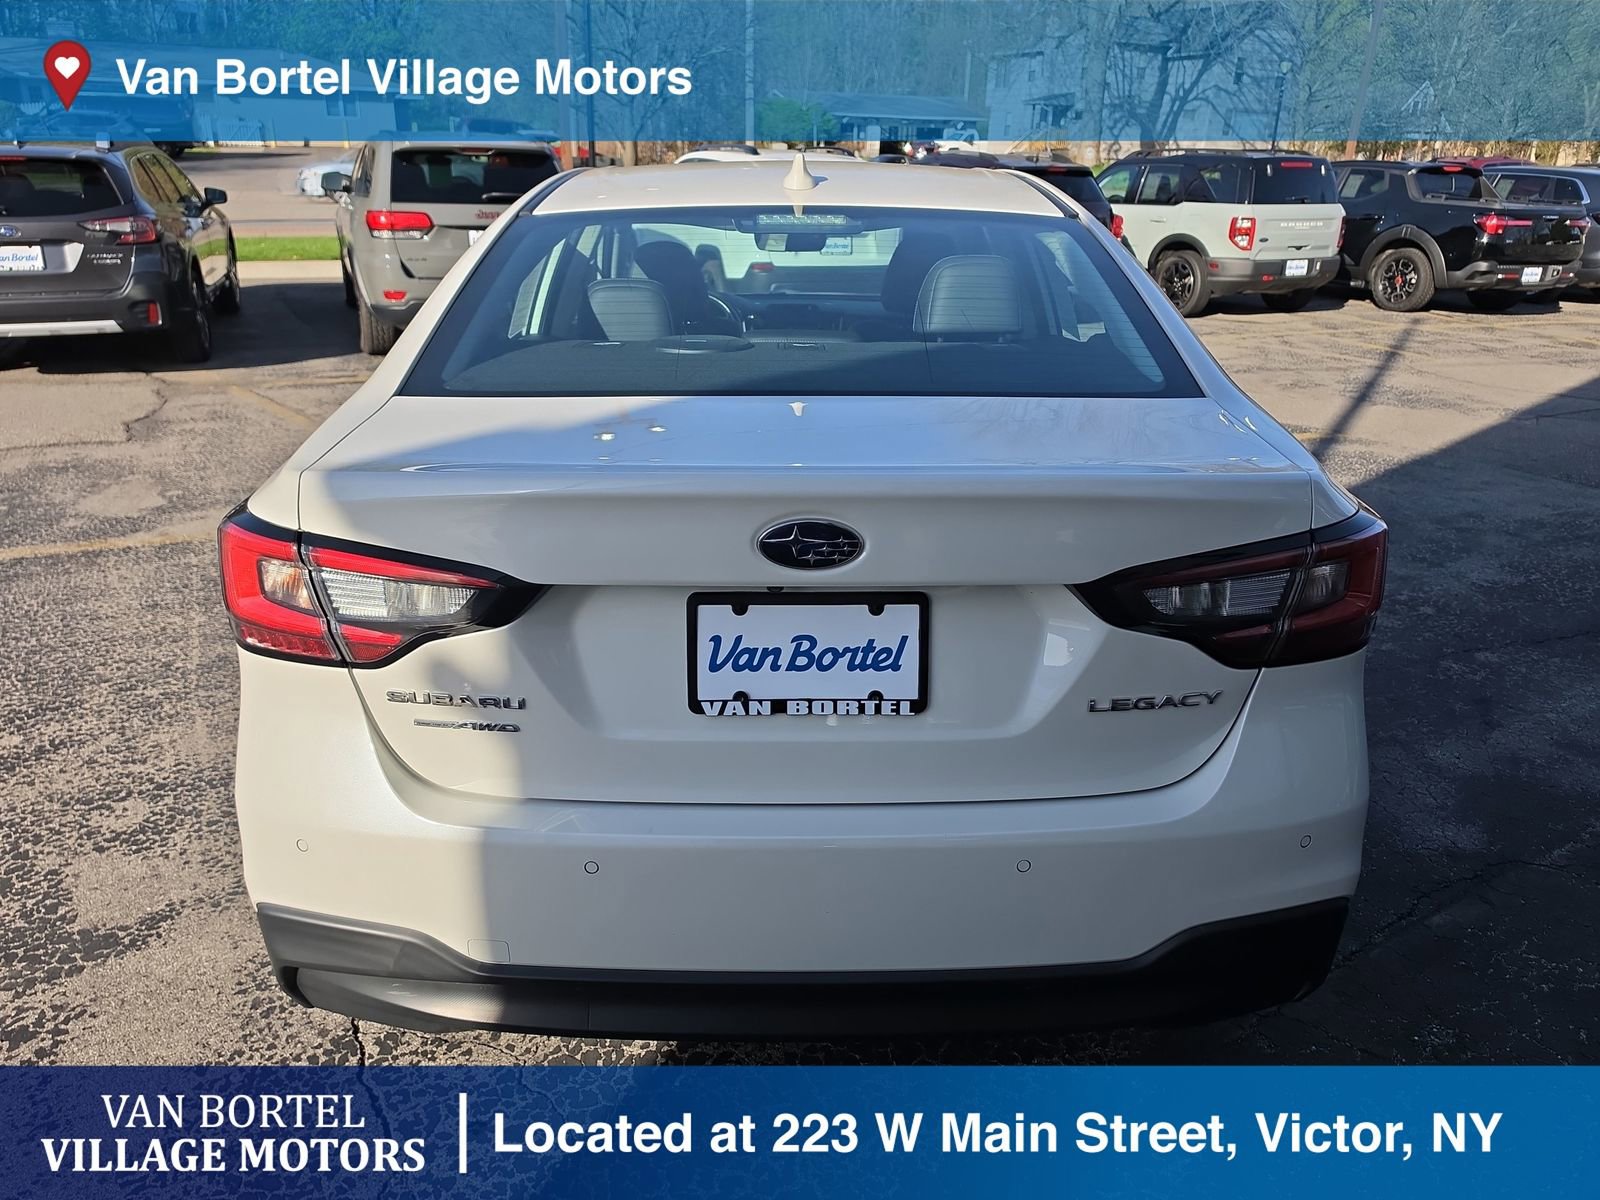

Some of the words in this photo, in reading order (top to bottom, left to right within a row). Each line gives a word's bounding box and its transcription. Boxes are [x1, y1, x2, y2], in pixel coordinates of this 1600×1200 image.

[708, 634, 782, 673] Van
[784, 634, 909, 673] Bortel
[386, 690, 527, 710] SUBARU
[700, 700, 772, 716] VAN
[786, 700, 915, 716] BORTEL
[1088, 689, 1223, 713] LEGACY
[453, 719, 521, 733] AWD
